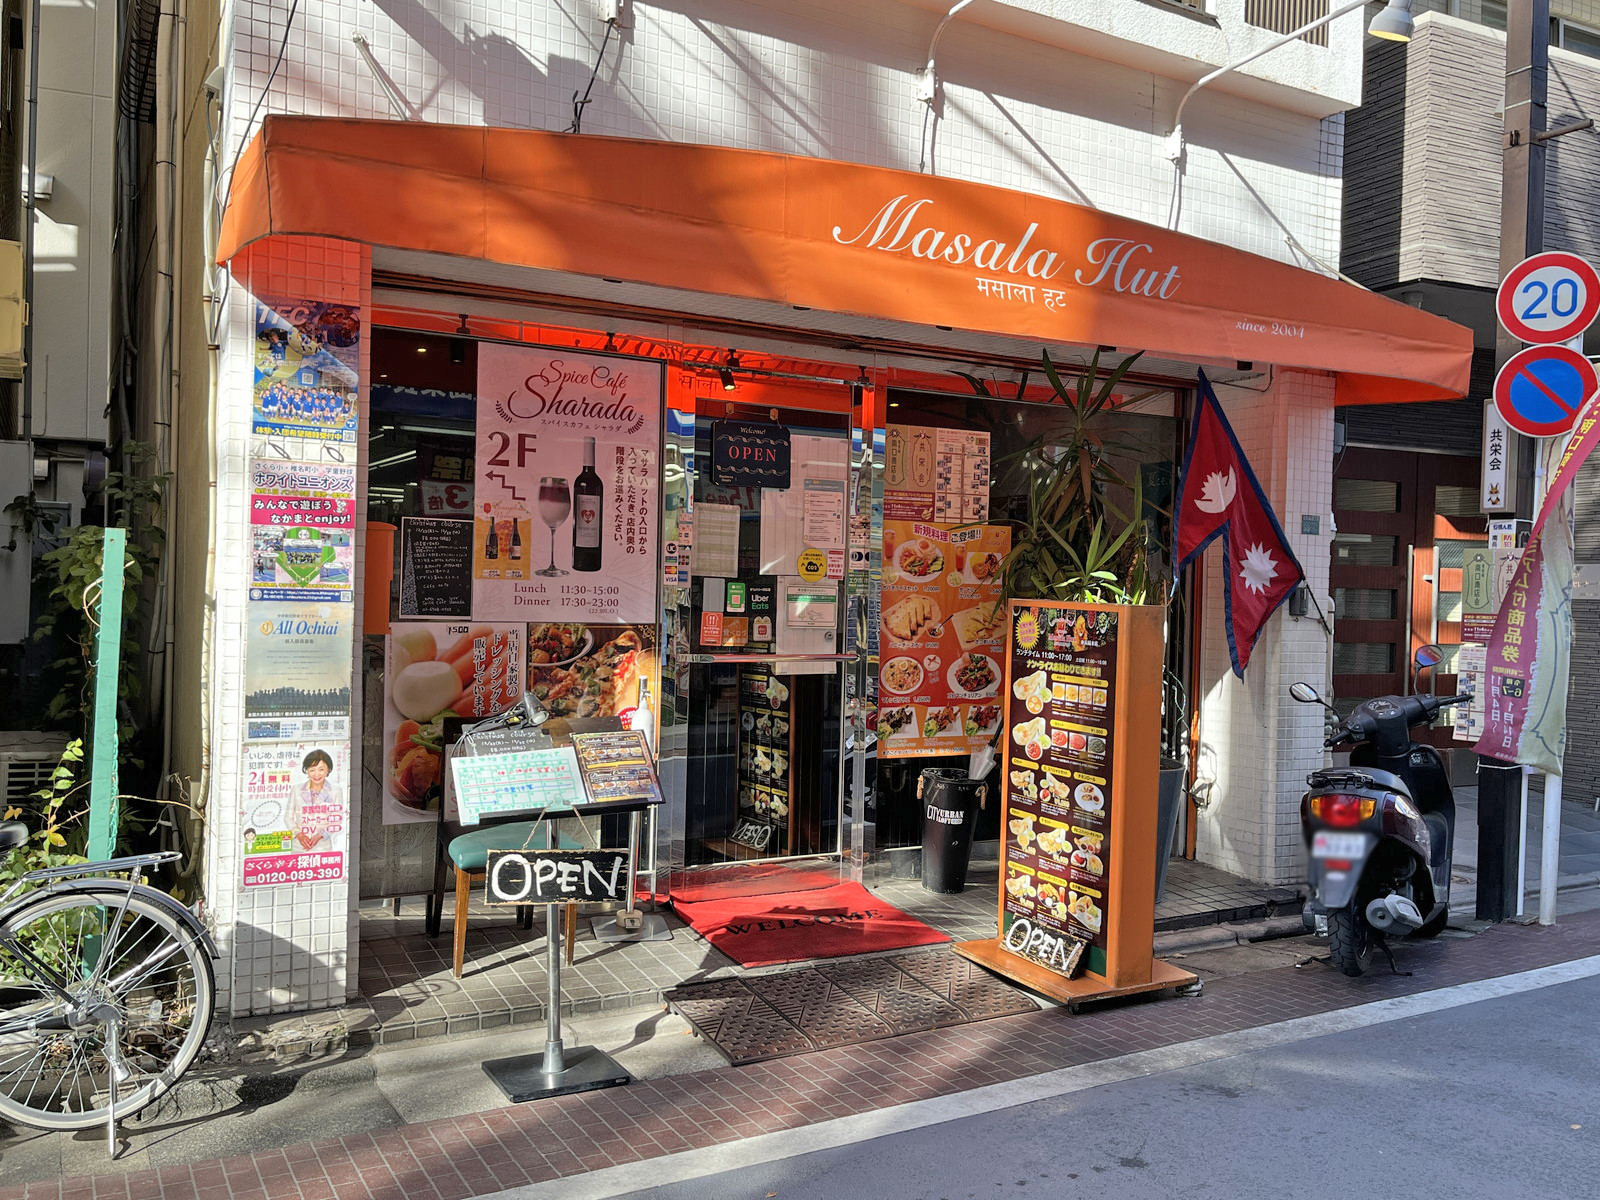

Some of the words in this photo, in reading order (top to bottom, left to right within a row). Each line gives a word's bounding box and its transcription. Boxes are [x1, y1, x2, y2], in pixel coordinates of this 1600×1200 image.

[833, 194, 1065, 280] Masala
[1075, 237, 1182, 299] Hut
[975, 277, 1036, 304] मसाला
[1521, 278, 1579, 320] 20
[259, 306, 309, 326] TFC
[1236, 319, 1267, 334] since
[1271, 321, 1306, 339] 2004
[540, 360, 588, 389] Spice
[591, 365, 629, 396] Café
[508, 374, 637, 422] Sharada
[541, 419, 591, 430] スパイスカフェ
[594, 424, 623, 432] シャラダ
[487, 431, 537, 468] 2F
[728, 445, 777, 462] OPEN
[1489, 428, 1503, 472] 共栄会
[254, 471, 354, 491] ホワイトユニオンズ
[254, 500, 332, 510] みんなで遊ぼう
[614, 446, 625, 547] 階段をお進みください。
[626, 447, 637, 555] 入っていただき、店内奥の
[638, 449, 649, 555] マサラハットの入口から
[270, 513, 351, 524] なかまとenjoy!
[913, 523, 949, 543] 新規料理
[951, 529, 981, 543] ご登場!!
[514, 583, 546, 594] Lunch
[751, 594, 770, 602] Uber
[514, 596, 550, 606] Dinner
[751, 602, 769, 610] Eats
[273, 621, 292, 635] All
[296, 621, 339, 635] Ochiai
[507, 629, 520, 698] 当店自家製の
[1016, 649, 1040, 658] ランチタイム
[473, 637, 487, 717] 販売しています
[489, 632, 504, 714] ドレッシングを
[249, 751, 301, 759] いじめ、虐待は
[249, 761, 283, 770] 犯罪です!
[248, 772, 265, 785] 24
[927, 805, 941, 821] CITY
[940, 809, 964, 819] URBAN
[302, 826, 317, 834] DV
[257, 867, 341, 884] 0120-089-390
[491, 853, 623, 901] OPEN
[725, 909, 883, 936] WELCOME
[1005, 918, 1081, 971] OPEN
